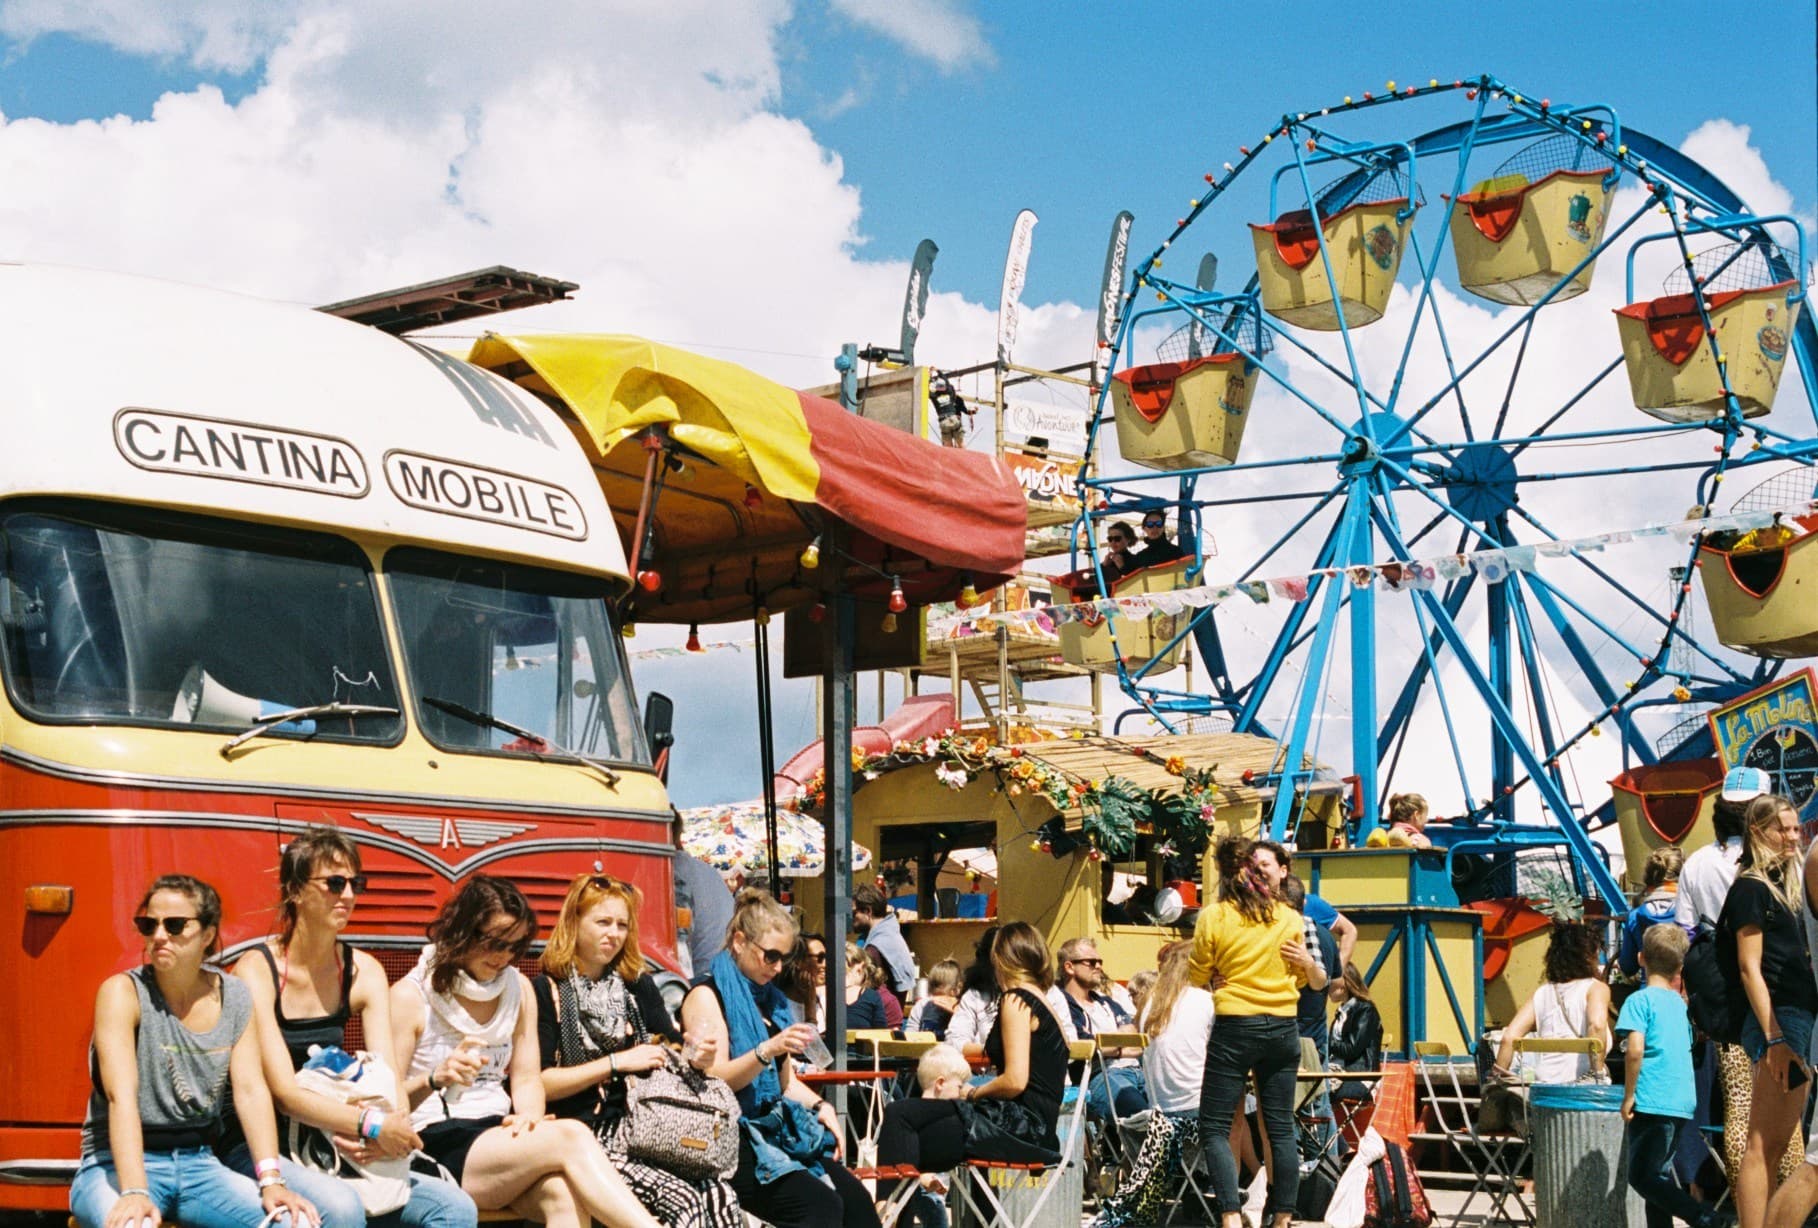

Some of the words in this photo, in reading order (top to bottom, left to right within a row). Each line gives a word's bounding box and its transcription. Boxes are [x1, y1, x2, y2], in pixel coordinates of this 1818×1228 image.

[125, 418, 362, 490] CANTINA
[398, 460, 575, 531] MOBILE
[1726, 711, 1752, 766] La
[441, 818, 460, 849] A
